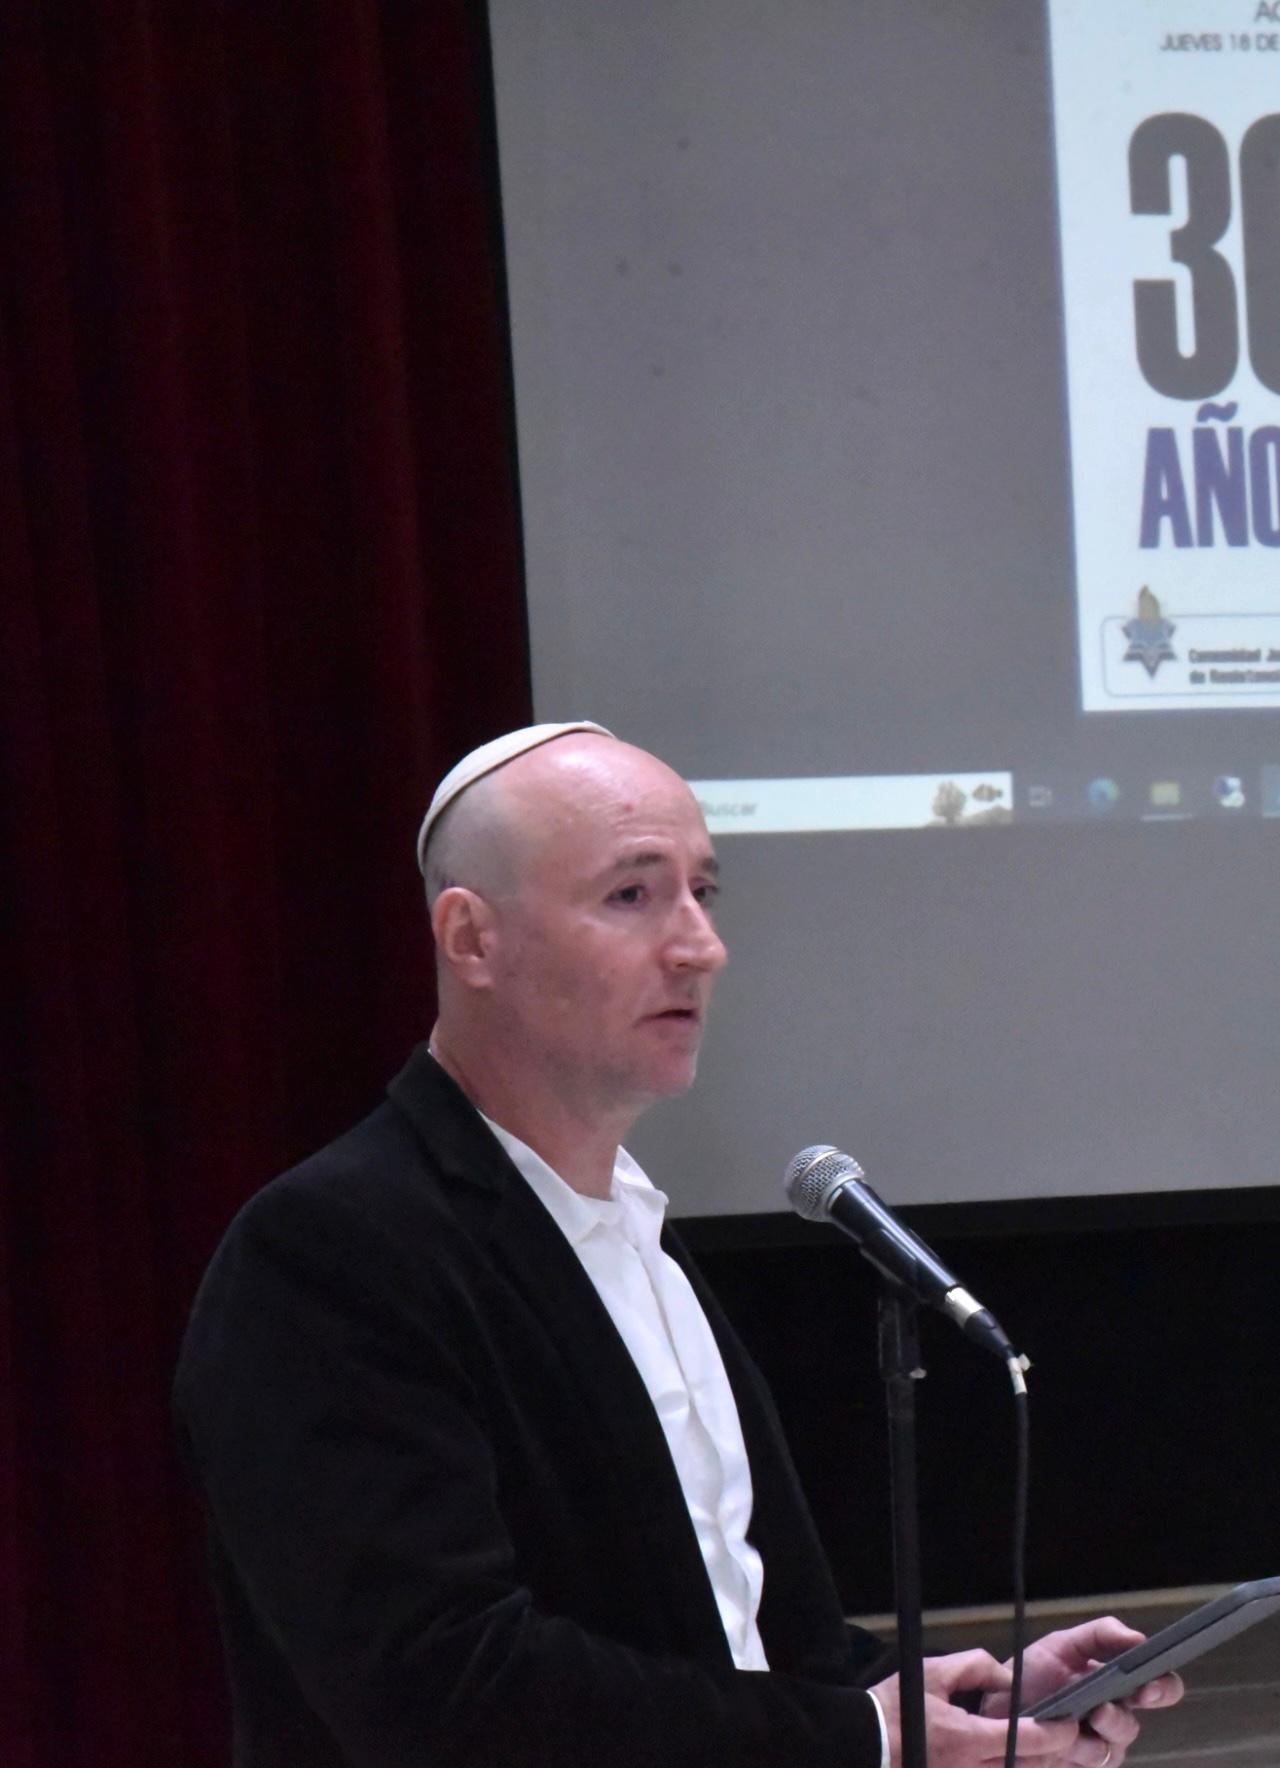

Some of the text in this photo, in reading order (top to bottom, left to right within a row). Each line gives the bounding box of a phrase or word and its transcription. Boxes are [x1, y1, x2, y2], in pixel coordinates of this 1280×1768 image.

[1159, 33, 1222, 51] JUEVES
[1231, 33, 1250, 51] 18
[1256, 33, 1280, 51] DE
